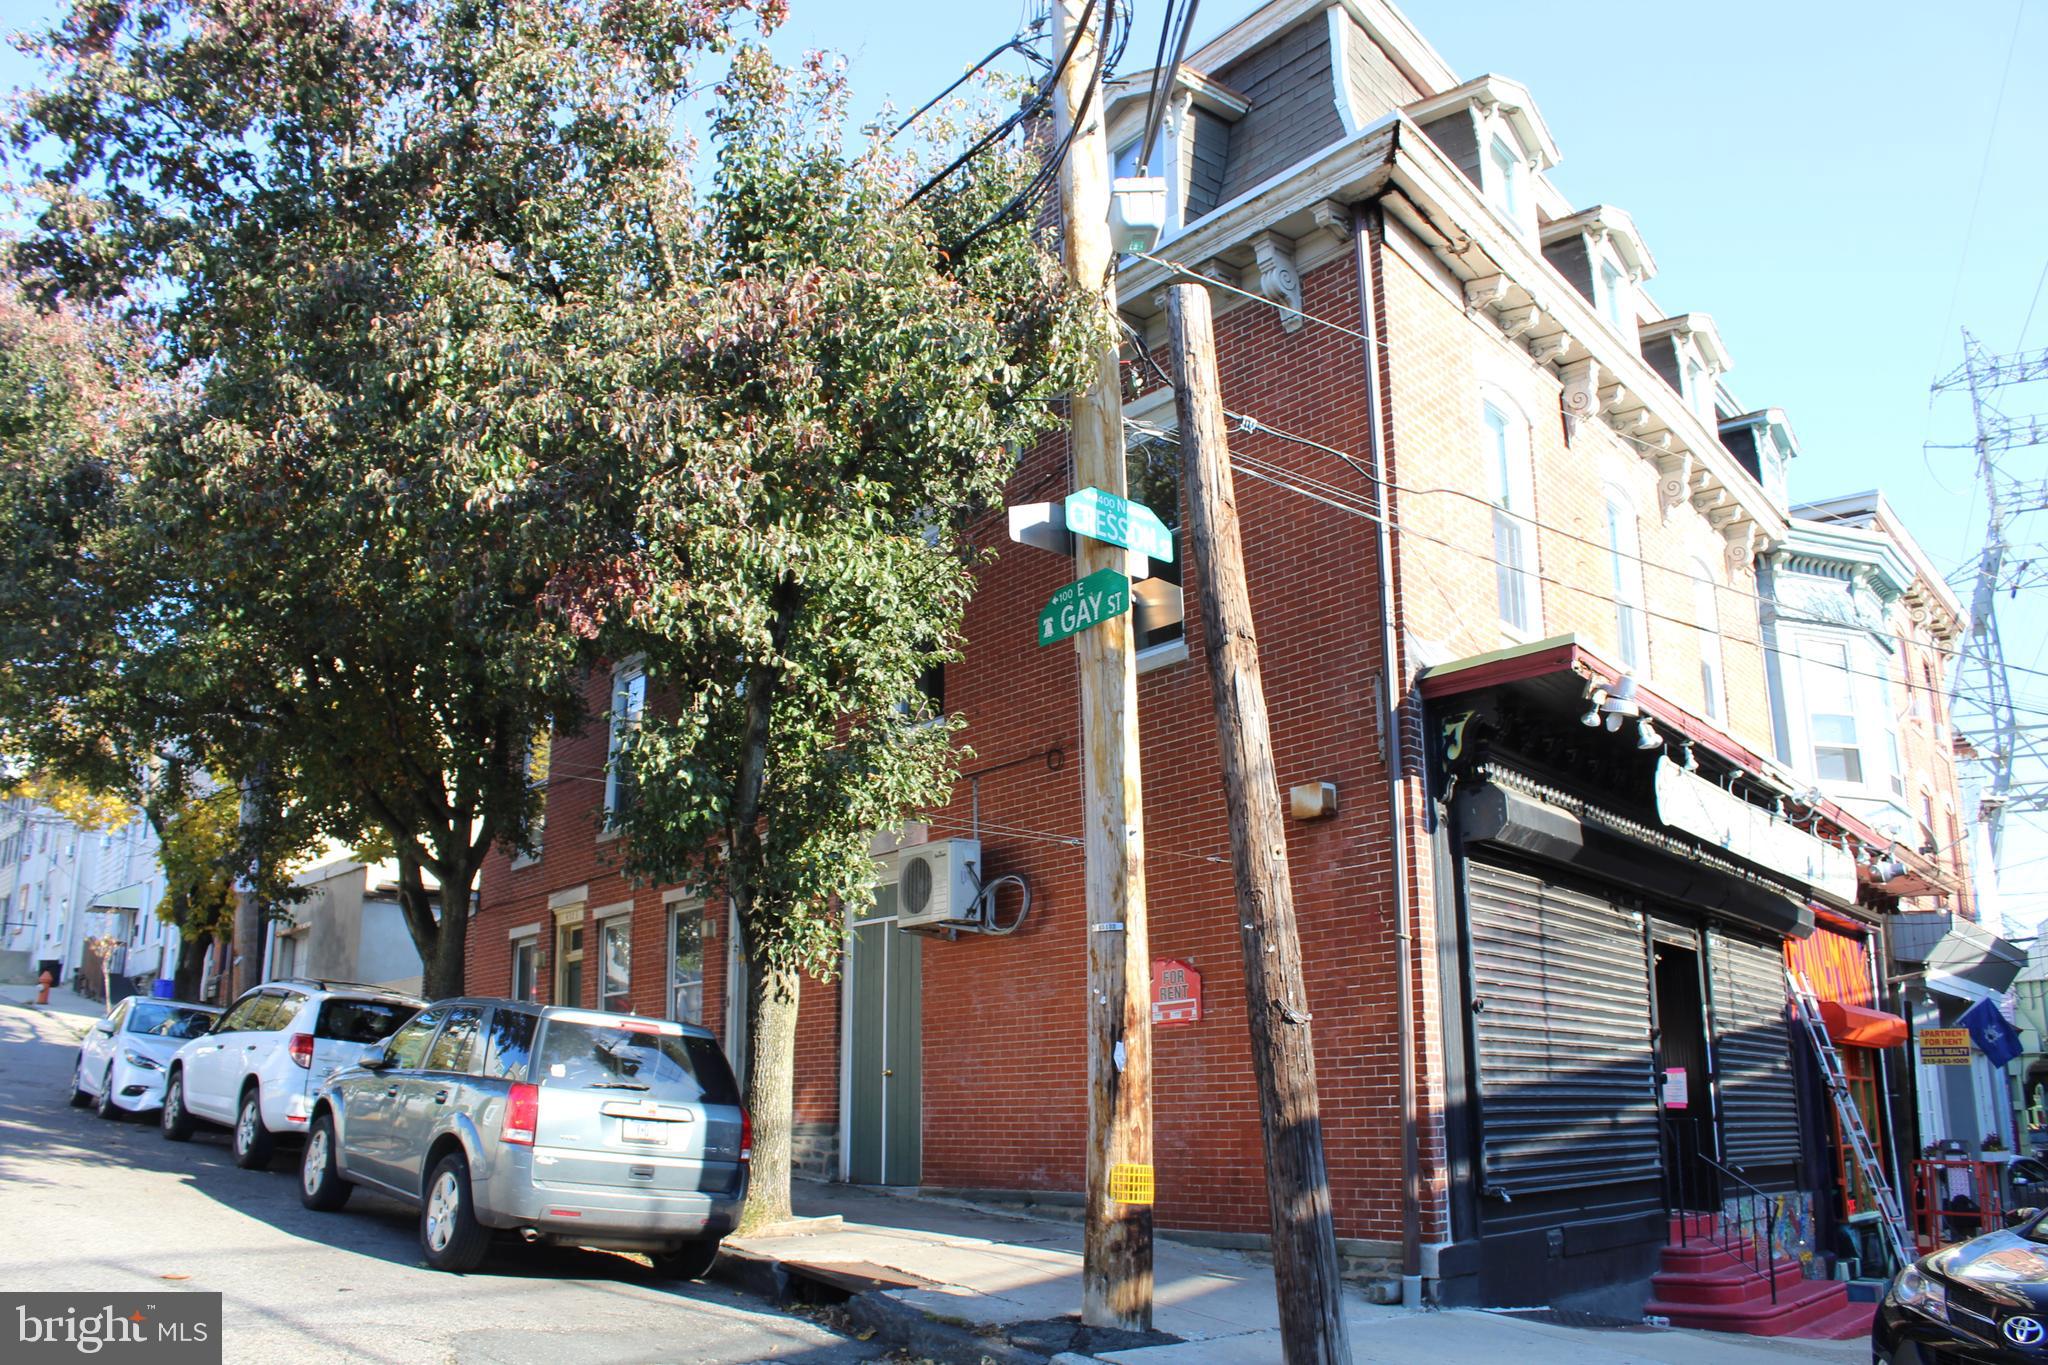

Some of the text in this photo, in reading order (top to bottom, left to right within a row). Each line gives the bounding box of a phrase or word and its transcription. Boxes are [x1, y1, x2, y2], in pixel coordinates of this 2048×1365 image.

[1097, 495, 1127, 514] 400 N
[1059, 582, 1085, 603] 100 E
[1060, 591, 1122, 633] GAY ST
[1162, 969, 1184, 984] FOR
[1159, 984, 1188, 1000] RENT
[1920, 1030, 1968, 1038] APARTMENT
[1925, 1038, 1963, 1046] FOR RENT
